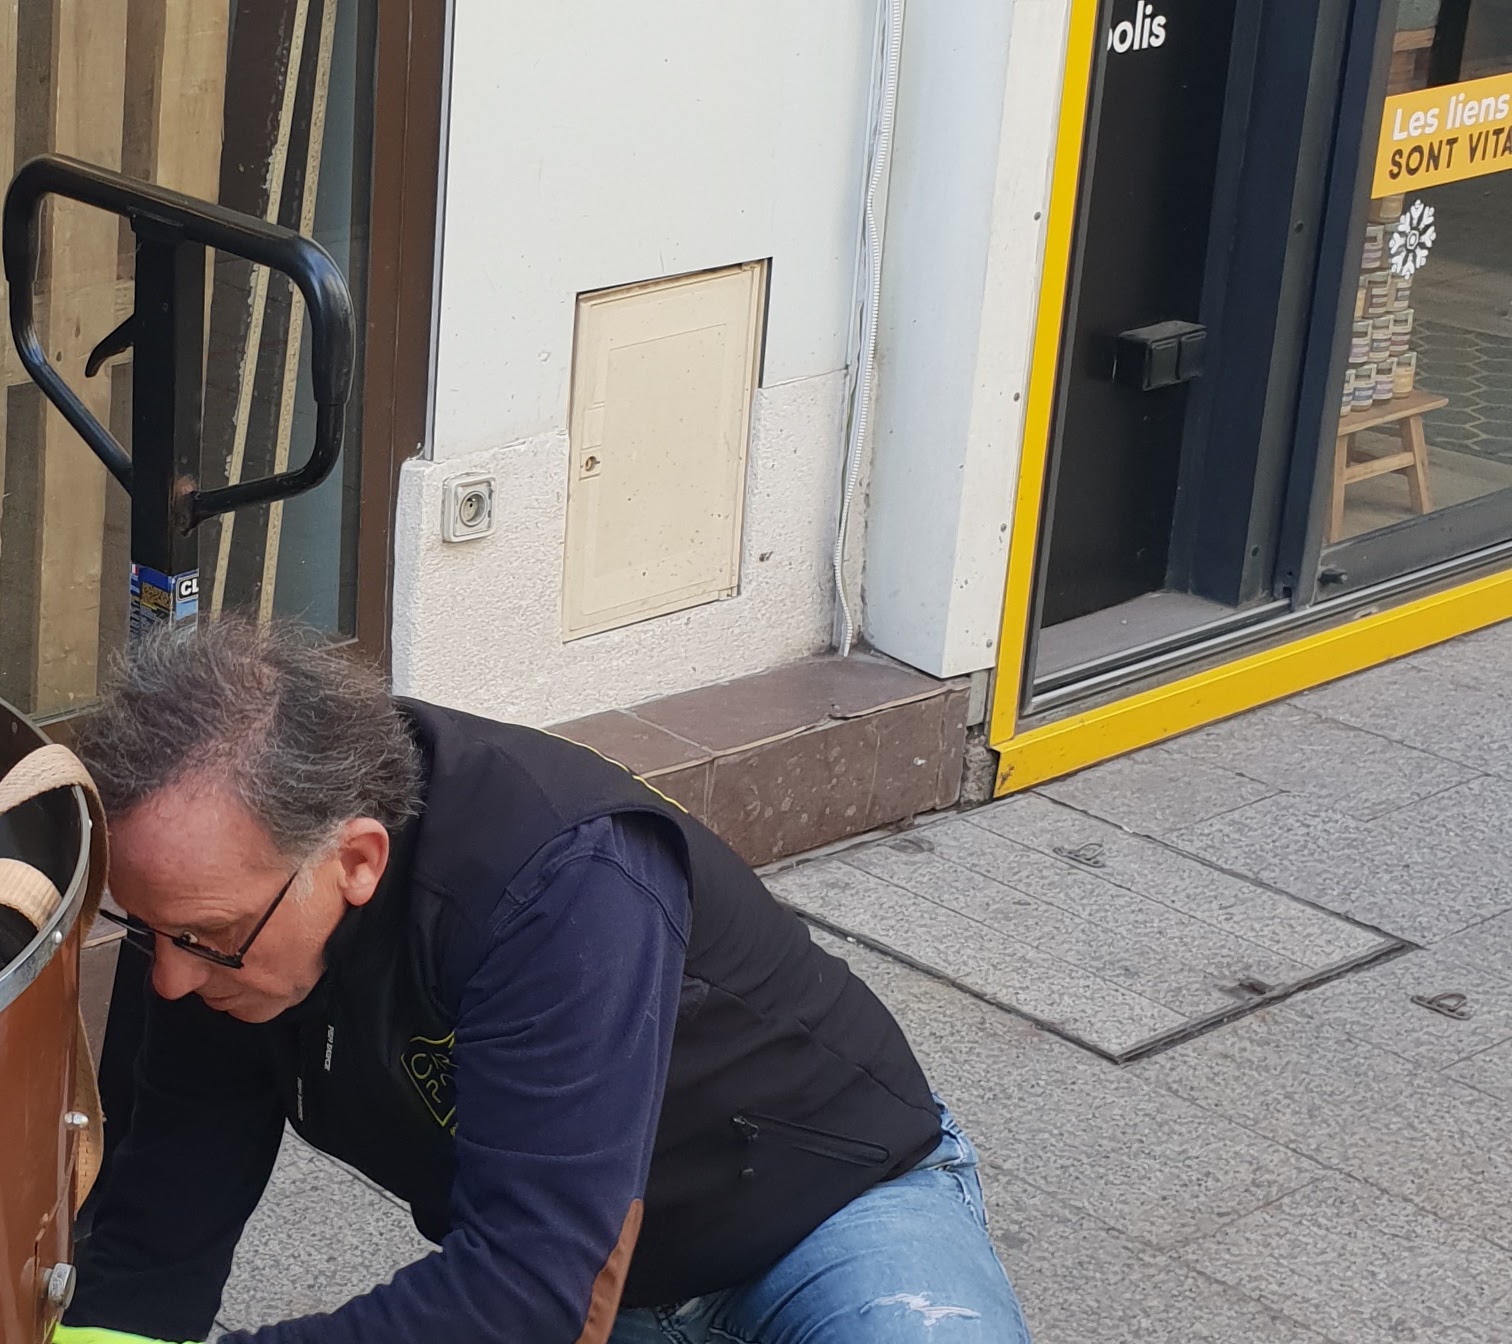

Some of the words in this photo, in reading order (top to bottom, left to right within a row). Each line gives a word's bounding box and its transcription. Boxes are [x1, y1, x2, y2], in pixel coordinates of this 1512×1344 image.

[1107, 0, 1167, 54] olis
[1392, 108, 1440, 141] Les
[1446, 92, 1510, 130] liens
[1388, 136, 1459, 181] SONT
